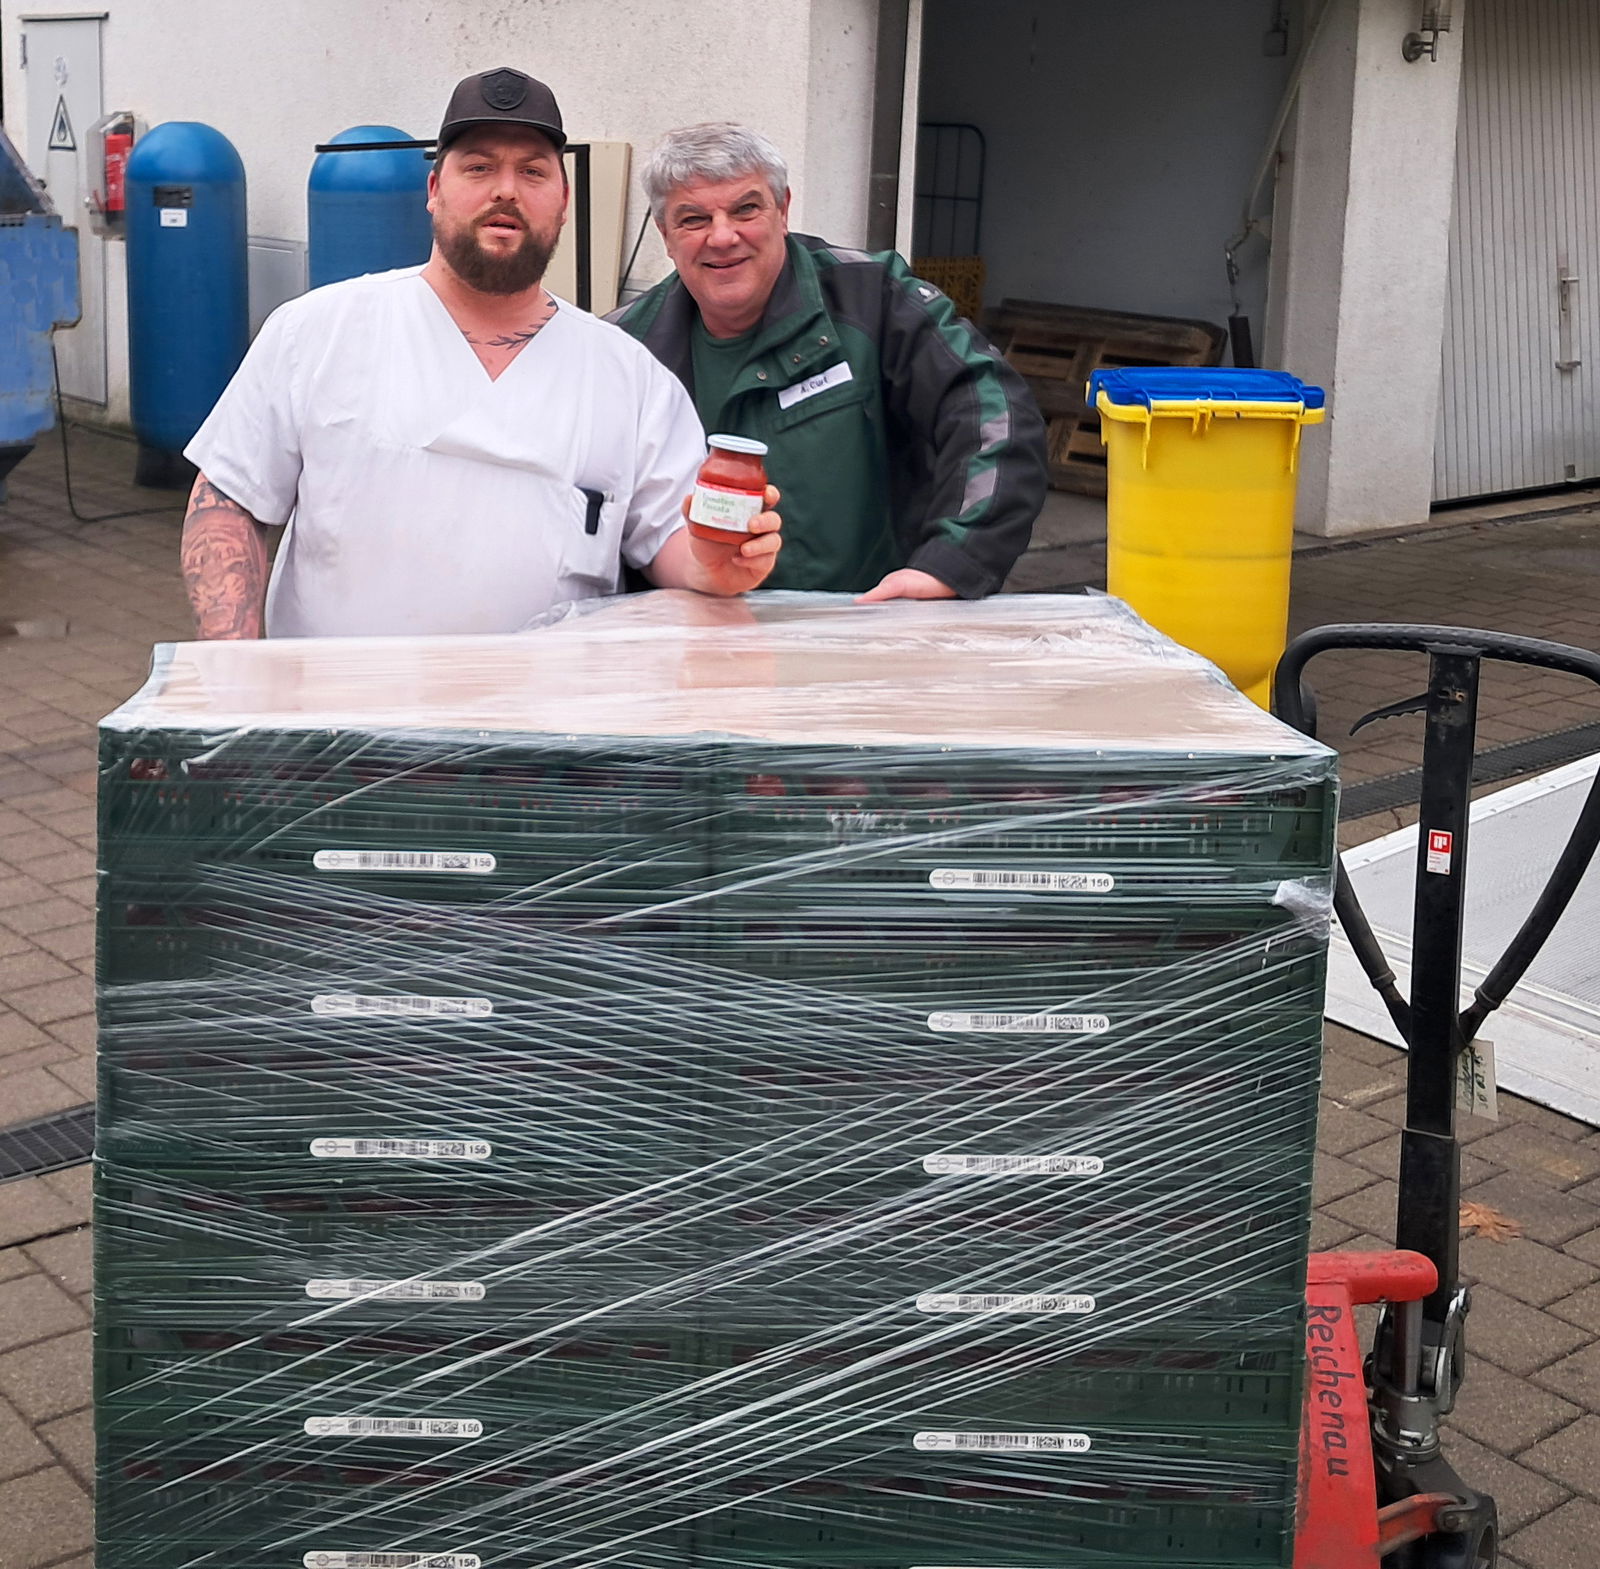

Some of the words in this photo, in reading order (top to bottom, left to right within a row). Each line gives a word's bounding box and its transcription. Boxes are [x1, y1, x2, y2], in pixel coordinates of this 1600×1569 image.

[474, 858, 491, 867] 156
[1091, 878, 1109, 887] 156
[1087, 1018, 1106, 1028] 156
[470, 1145, 487, 1154] 156
[1306, 1304, 1356, 1477] Reichenau
[462, 1423, 480, 1433] 156
[1068, 1438, 1086, 1447] 156
[459, 1558, 476, 1568] 156
